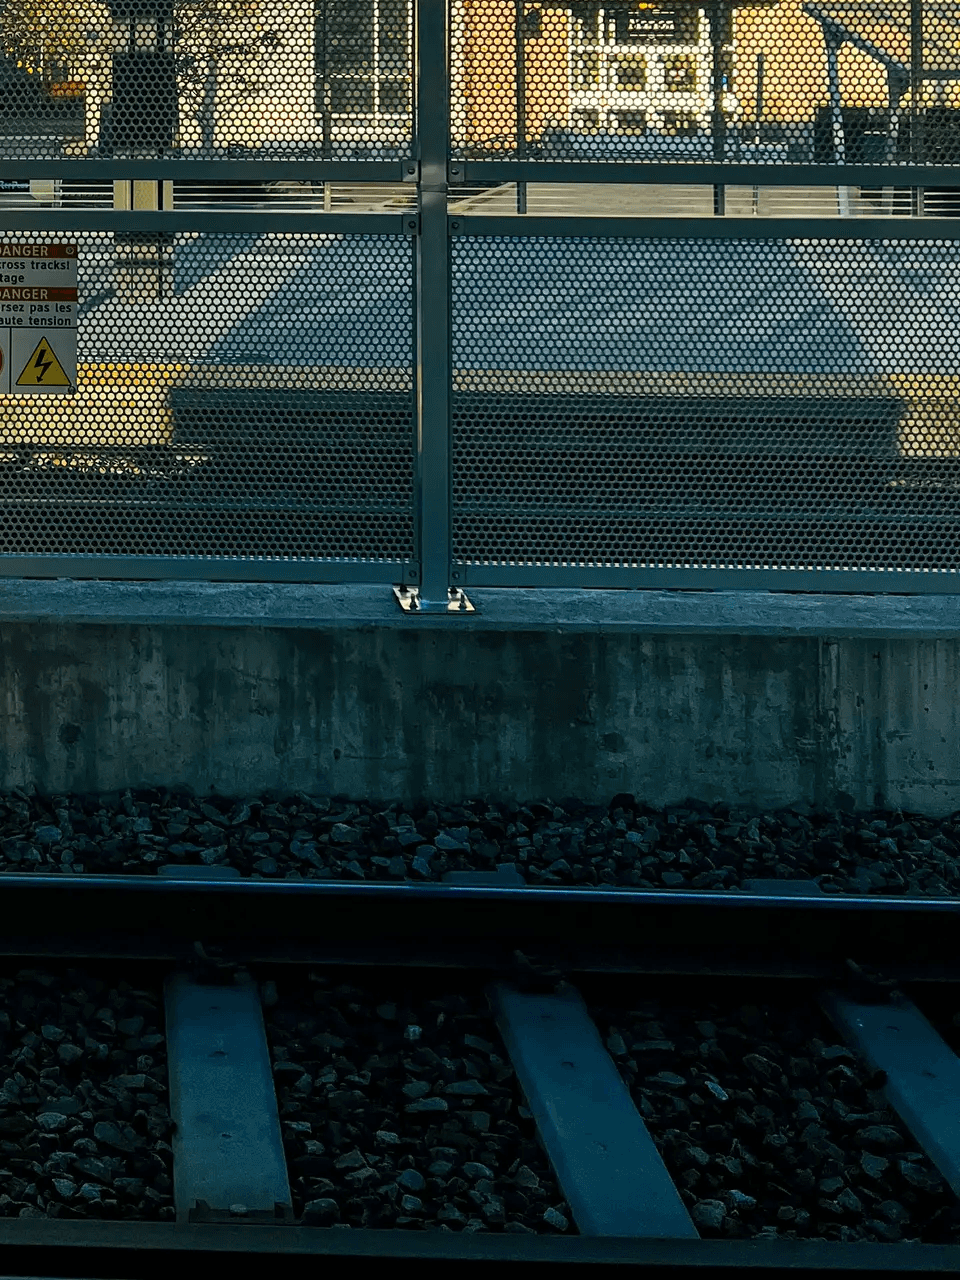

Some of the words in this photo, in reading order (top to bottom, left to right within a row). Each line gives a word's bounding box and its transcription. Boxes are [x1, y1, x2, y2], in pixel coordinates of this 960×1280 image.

[30, 260, 70, 270] tracks!
[29, 304, 50, 313] pas
[55, 303, 72, 313] les
[29, 315, 71, 326] tension
